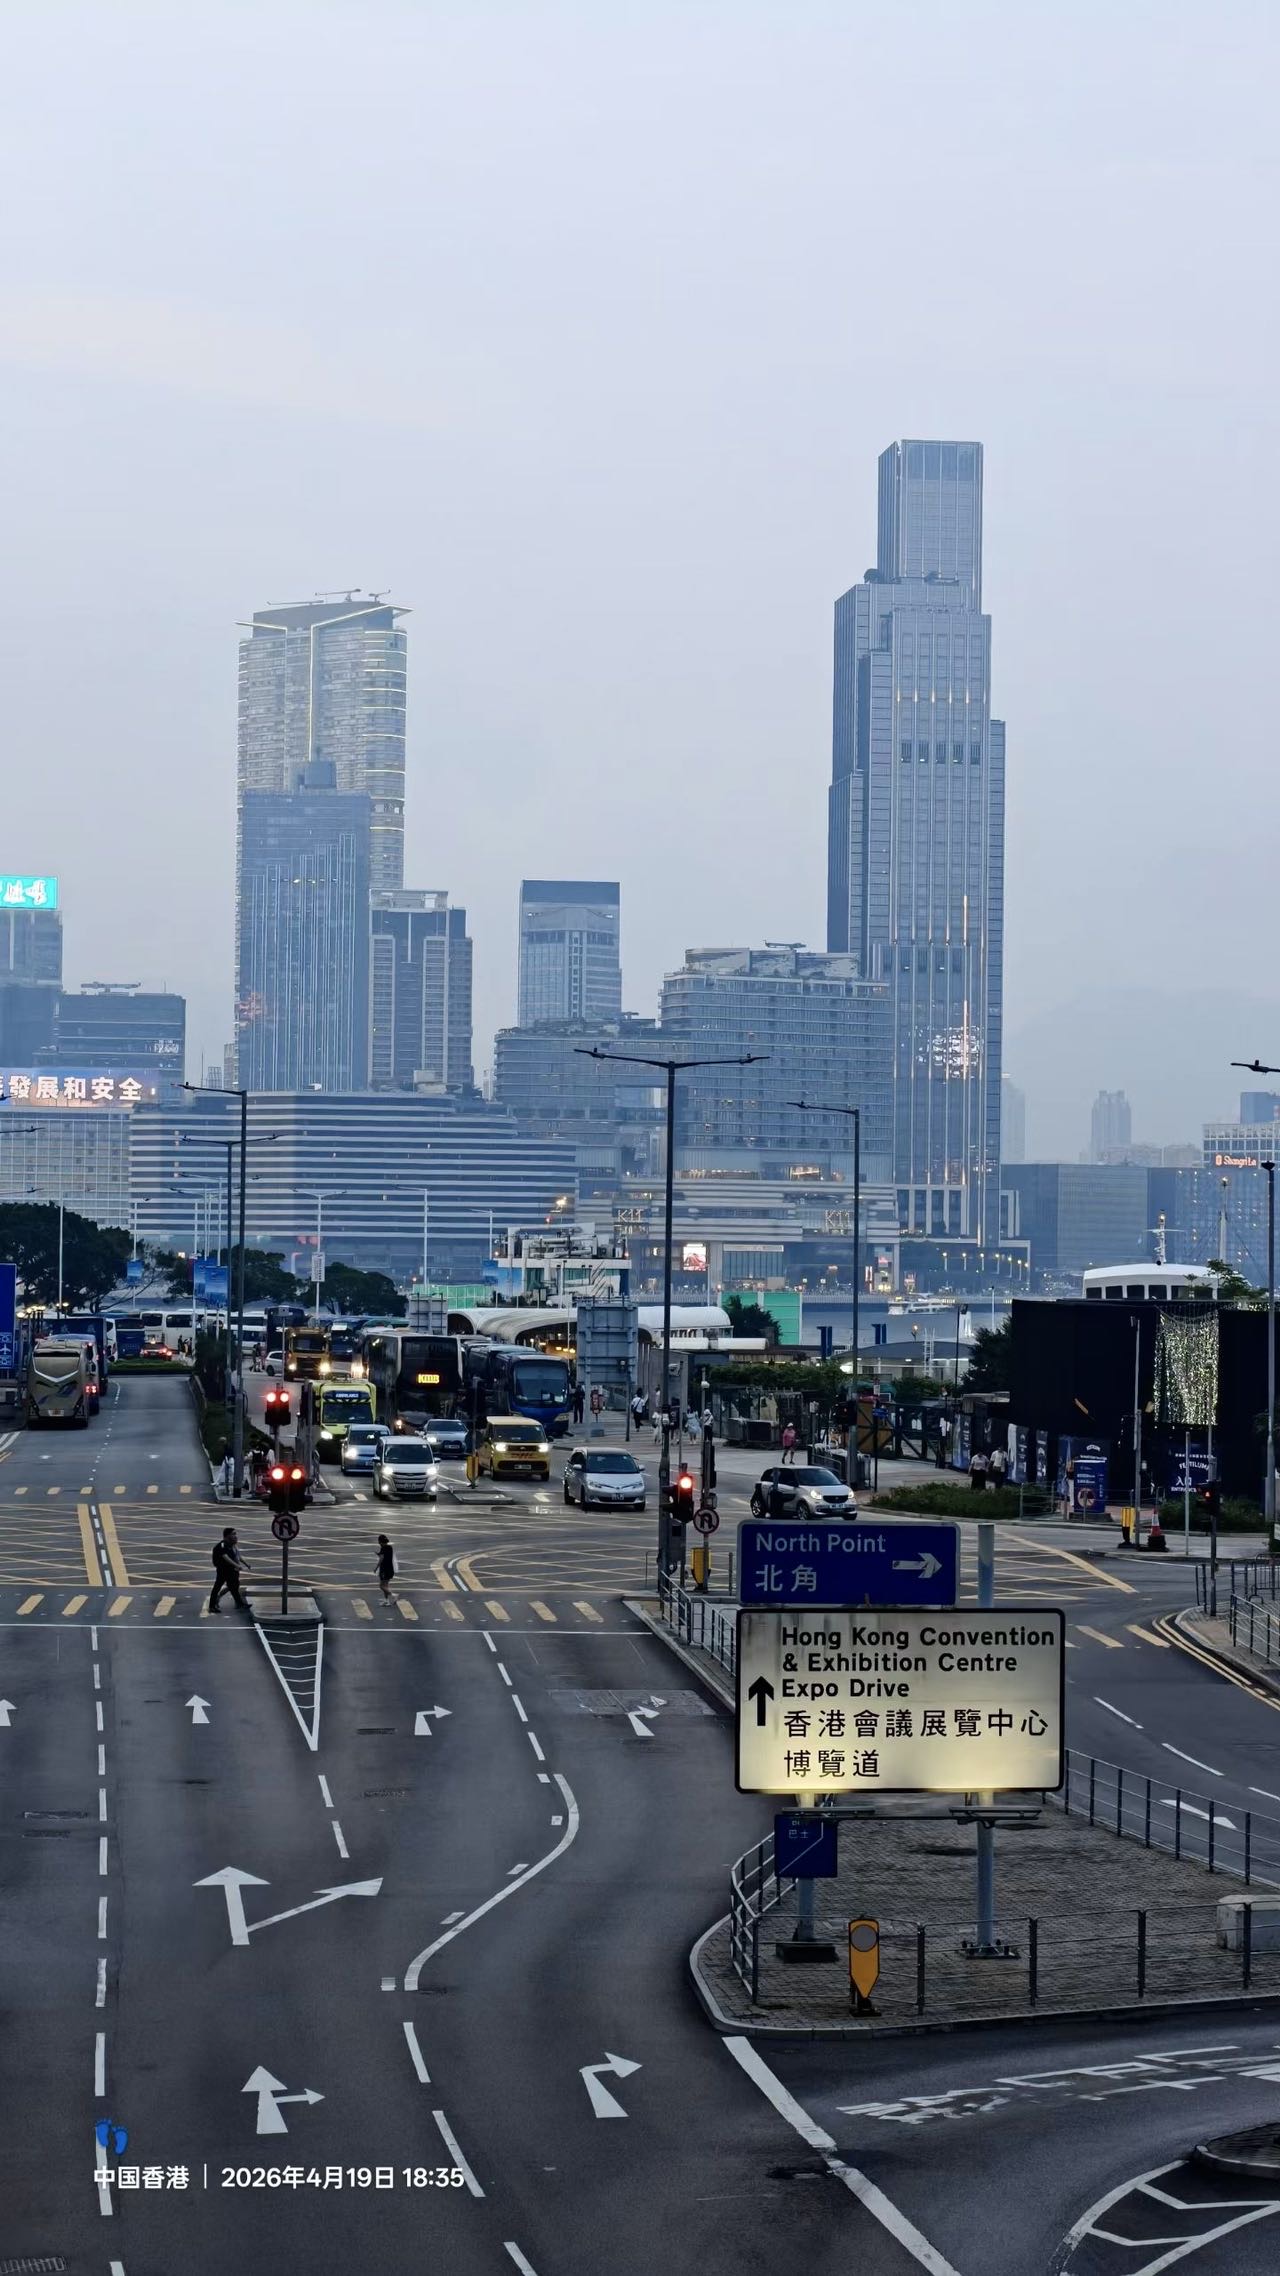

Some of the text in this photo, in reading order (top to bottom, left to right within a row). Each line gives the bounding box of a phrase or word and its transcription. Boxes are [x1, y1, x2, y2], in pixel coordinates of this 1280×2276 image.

[0, 1075, 142, 1100] 發展和安全
[755, 1533, 887, 1553] North Point
[755, 1564, 818, 1593] 北角
[782, 1626, 1055, 1650] Hong Kong Convention
[782, 1652, 1018, 1672] & Exhibition Centre
[782, 1678, 910, 1702] Expo Drive
[783, 1708, 1050, 1739] 香港會議展覽中心
[783, 1748, 881, 1779] 博覽道
[788, 1829, 808, 1839] 巴士
